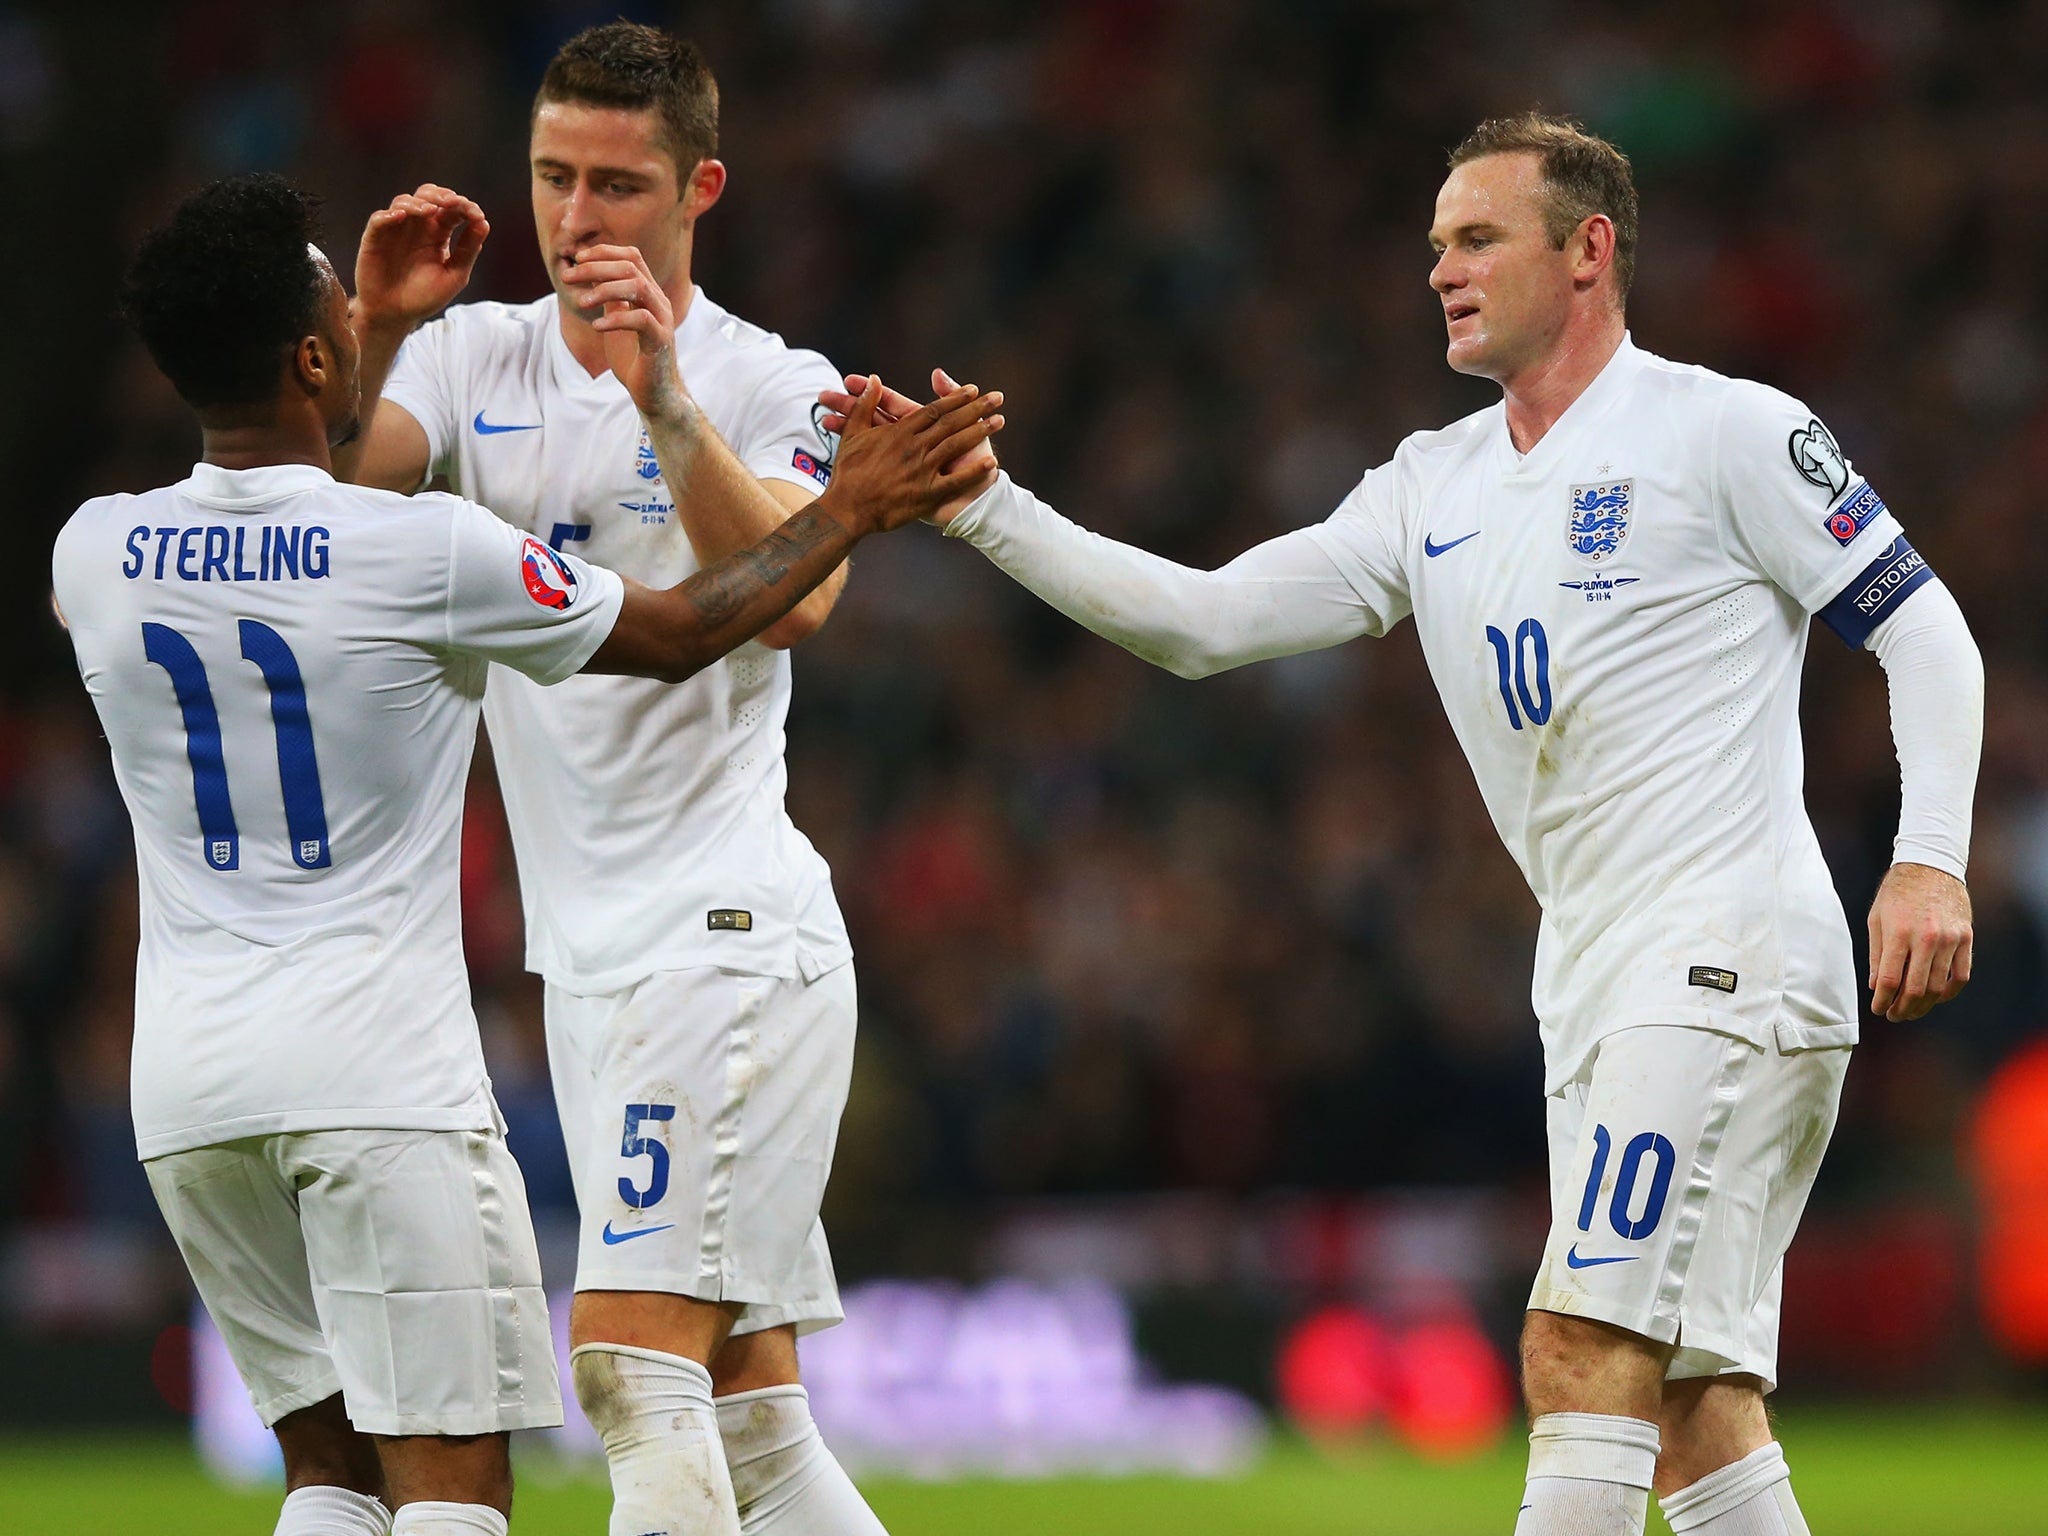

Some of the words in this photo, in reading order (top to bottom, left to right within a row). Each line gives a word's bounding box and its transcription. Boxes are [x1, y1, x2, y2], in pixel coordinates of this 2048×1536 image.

[641, 504, 667, 512] SLOVENIA
[123, 525, 330, 581] STERLING
[1583, 580, 1613, 590] SLOVENIA
[1857, 588, 1883, 613] NO
[1879, 570, 1901, 590] TO
[1485, 618, 1552, 731] 10
[141, 618, 331, 871] 11
[617, 1104, 676, 1209] 5
[1577, 1123, 1676, 1240] 10
